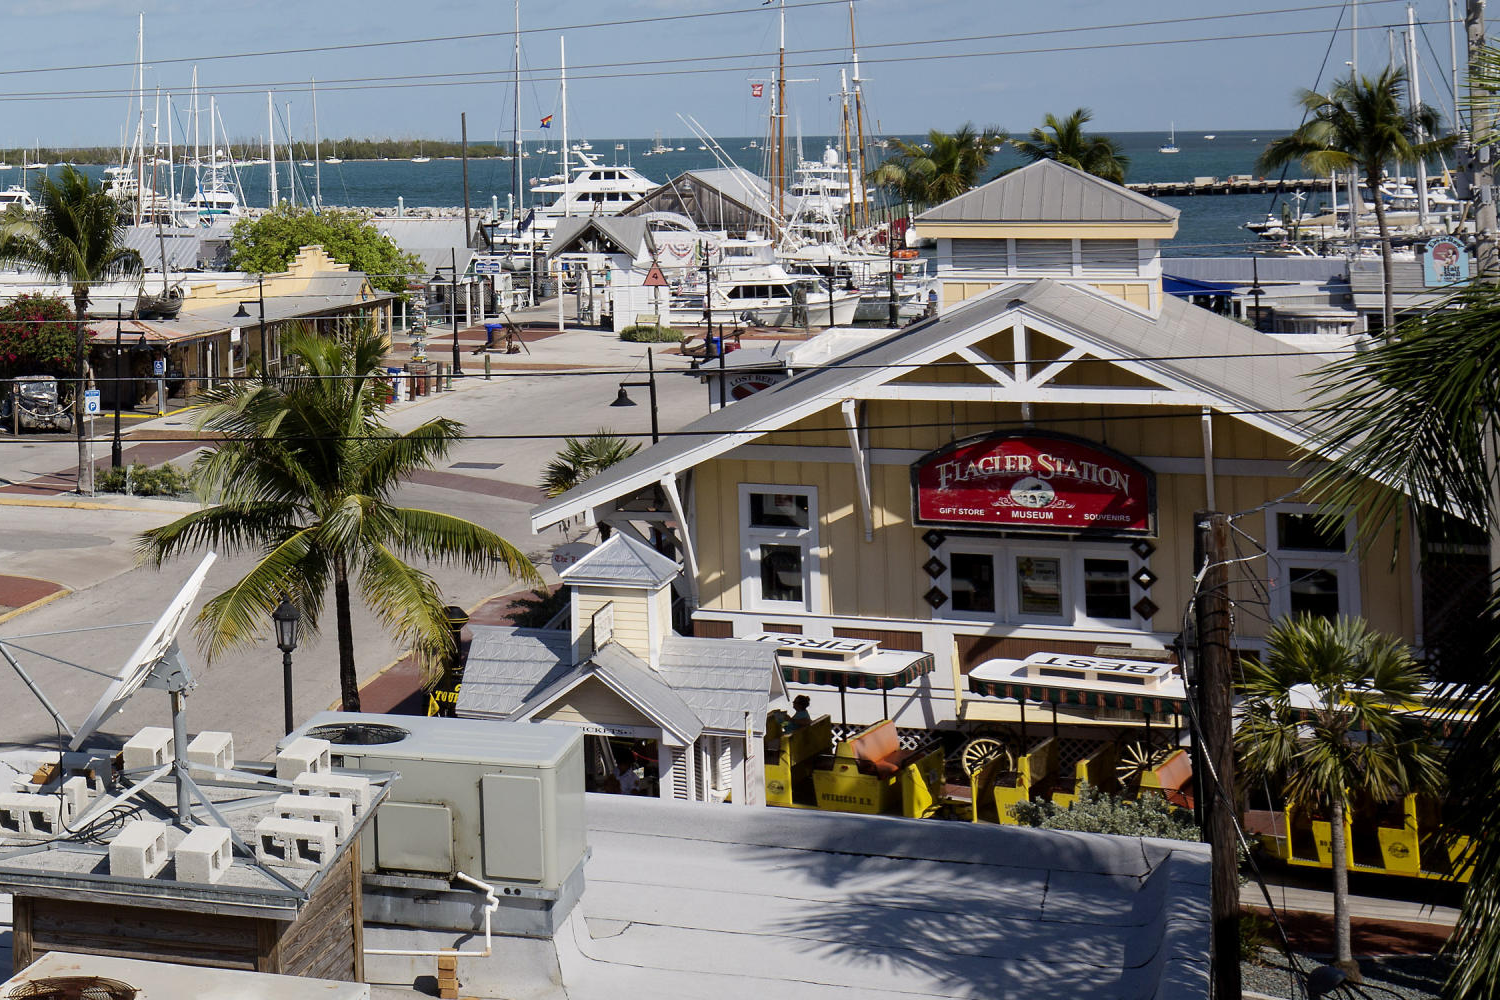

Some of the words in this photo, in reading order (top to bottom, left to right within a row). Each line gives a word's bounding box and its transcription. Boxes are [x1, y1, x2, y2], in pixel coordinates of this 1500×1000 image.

[652, 272, 658, 280] 4
[730, 375, 752, 387] LOST
[935, 454, 1033, 492] FLAGLER
[1037, 453, 1131, 497] STATION
[939, 507, 956, 515] GIFT
[958, 507, 985, 516] STORE
[1011, 510, 1054, 520] MUSEUM
[1084, 513, 1131, 522] SOUVENIRS
[1035, 657, 1160, 674] BEST
